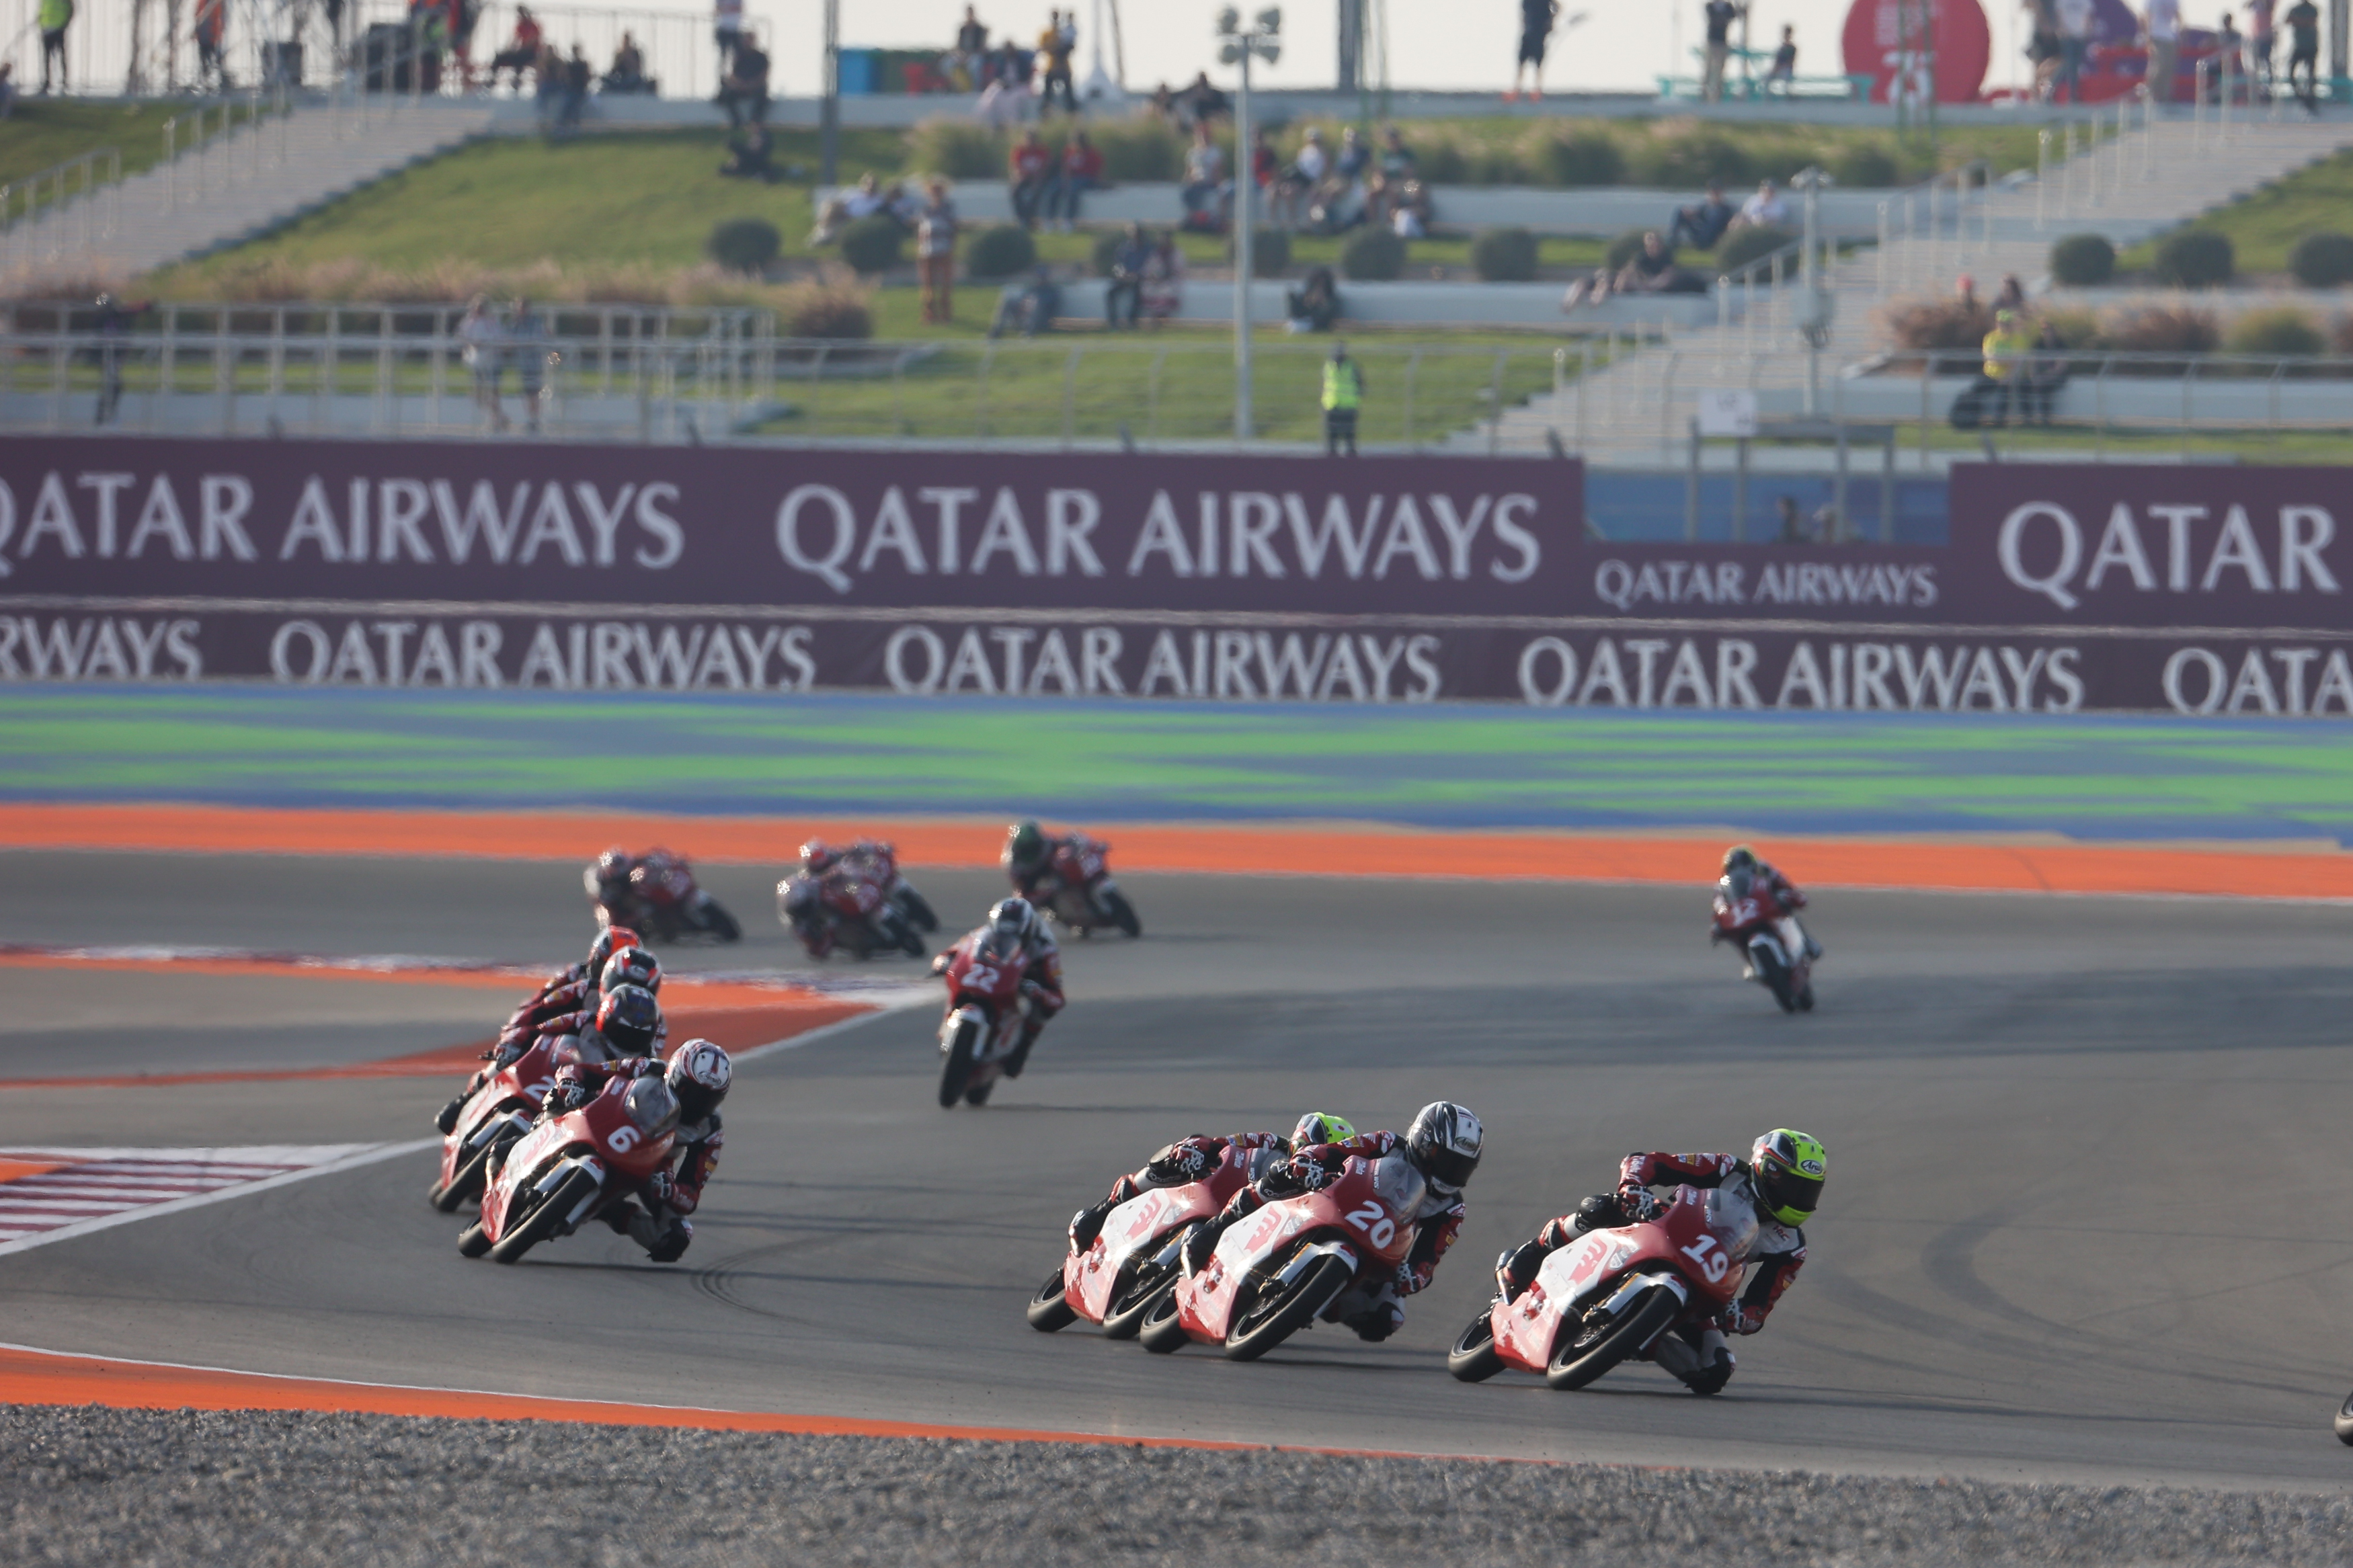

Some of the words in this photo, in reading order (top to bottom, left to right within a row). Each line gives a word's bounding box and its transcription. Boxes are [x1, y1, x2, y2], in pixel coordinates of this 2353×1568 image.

[0, 470, 257, 578] ATAR
[279, 474, 684, 569] AIRWAYS
[776, 483, 1105, 593] QATAR
[1127, 489, 1540, 582] AIRWAYS
[1595, 559, 1746, 610] QATAR
[1753, 561, 1938, 606] AIRWAYS
[1997, 501, 2340, 609] QATAR
[519, 622, 817, 692] AIRWAYS
[1142, 628, 1440, 702] AIRWAYS
[1776, 640, 2084, 712] AIRWAYS
[961, 963, 1000, 993] 22
[608, 1125, 641, 1153] 6
[1805, 1161, 1821, 1172] Arai
[1345, 1200, 1395, 1249] 20
[1680, 1234, 1728, 1283] 19
